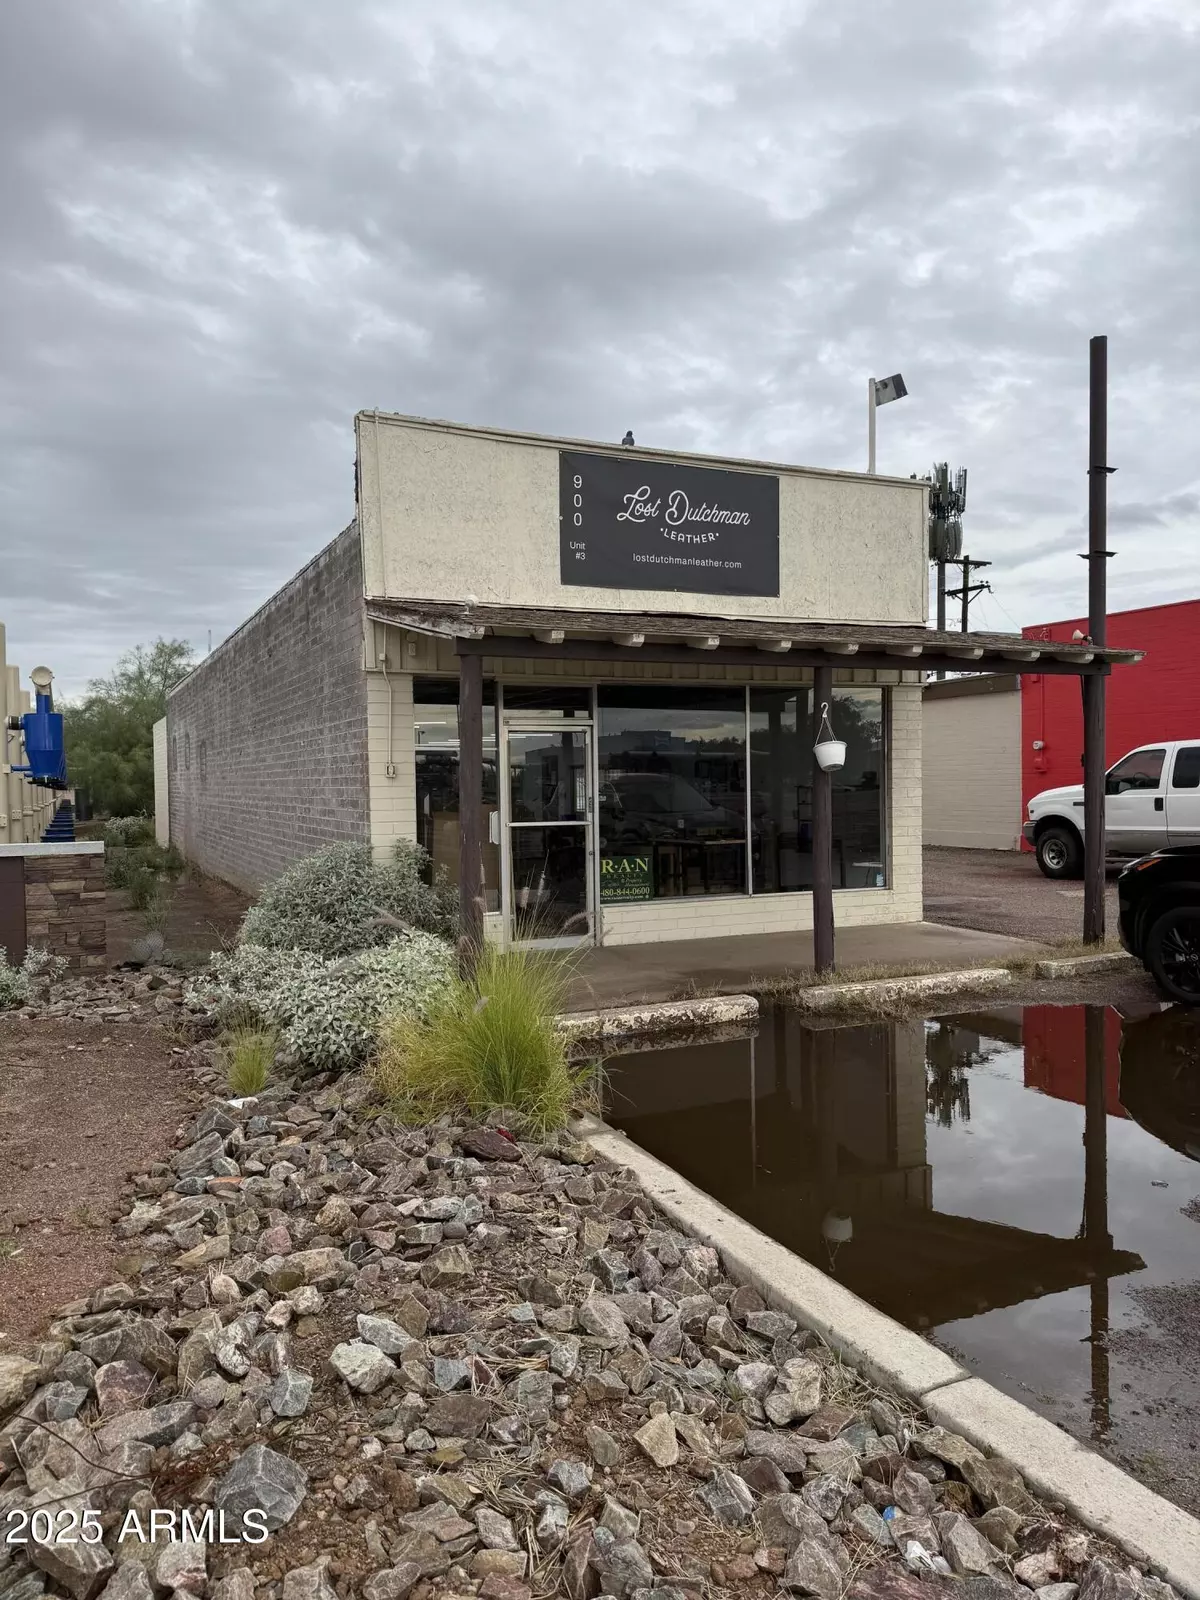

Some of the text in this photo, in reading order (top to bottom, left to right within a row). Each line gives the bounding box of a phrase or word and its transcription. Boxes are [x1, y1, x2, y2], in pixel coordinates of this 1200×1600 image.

[616, 485, 751, 526] Lost Dutchman
[569, 541, 586, 550] Unit
[575, 551, 586, 560] #3
[632, 553, 742, 569] lostdutchmanleather.com
